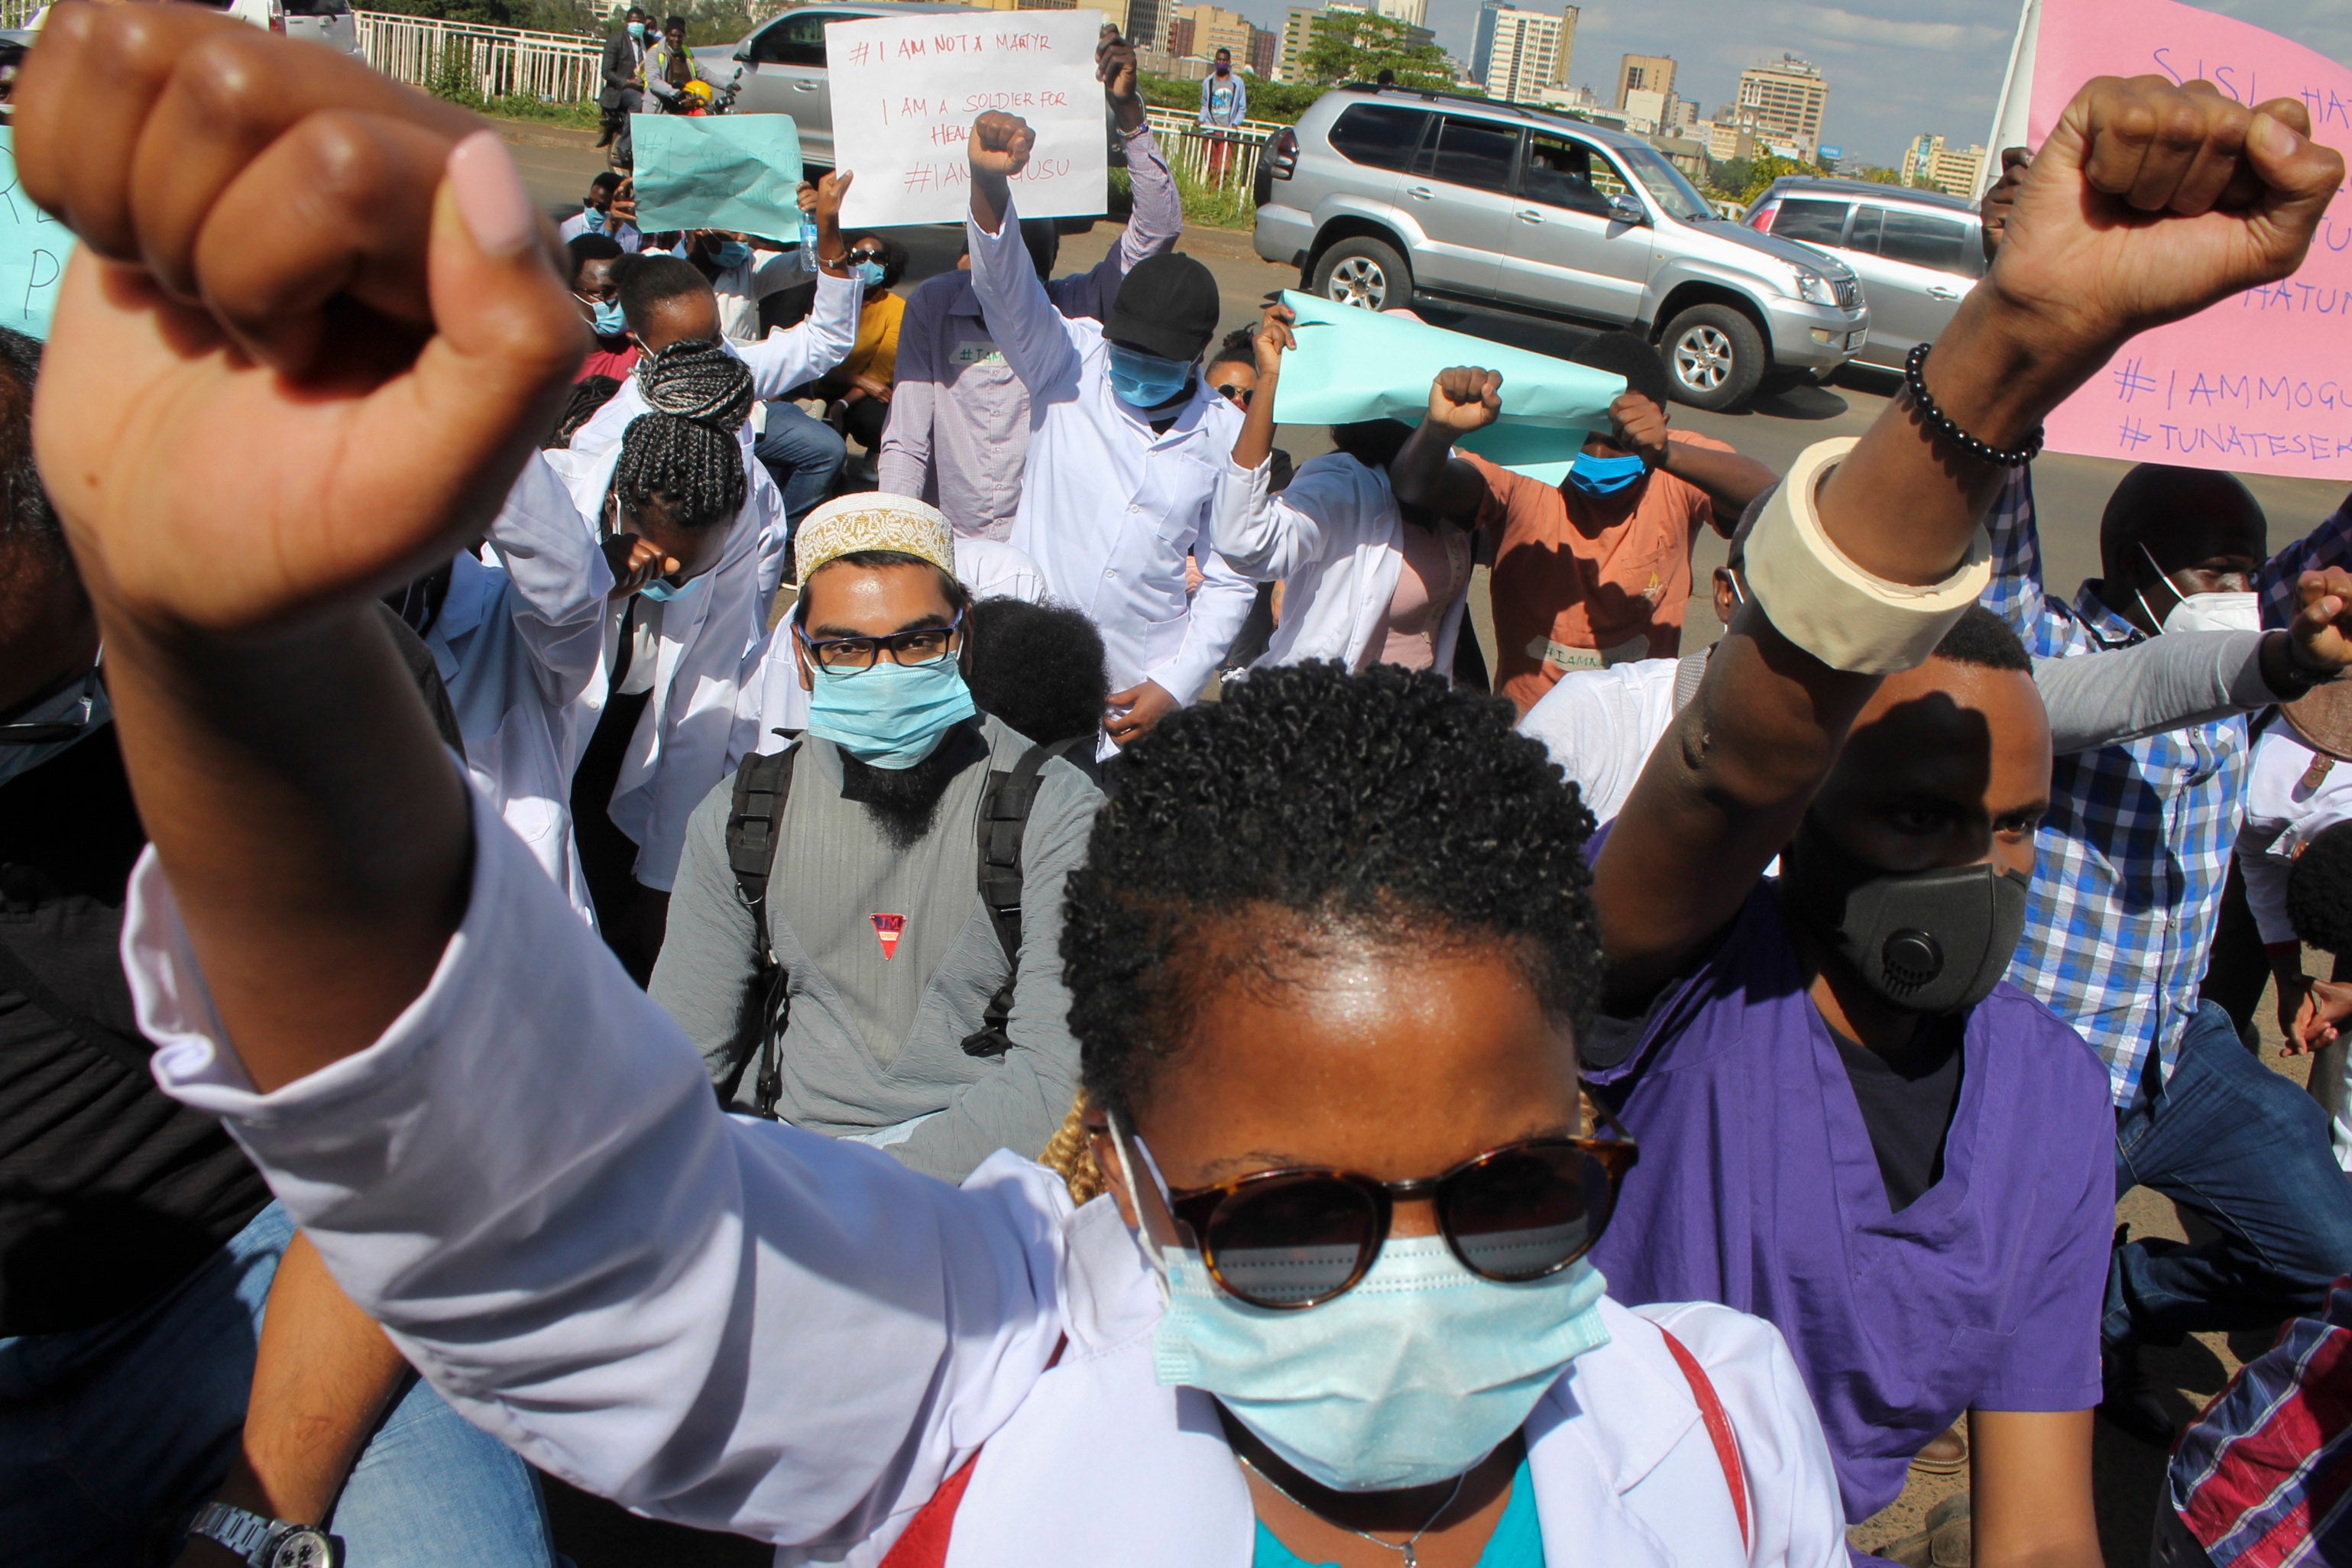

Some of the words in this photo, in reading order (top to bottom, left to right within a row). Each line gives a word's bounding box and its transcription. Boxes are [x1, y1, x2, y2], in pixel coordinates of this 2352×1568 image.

[898, 38, 926, 60] AM
[935, 34, 967, 54] NOT
[996, 32, 1052, 53] MARTYR
[882, 99, 888, 125] I
[901, 97, 927, 118] AM
[939, 99, 949, 115] A
[962, 92, 1035, 112] SOLDIER
[1040, 91, 1067, 108] FOR
[2301, 86, 2352, 129] HA
[931, 123, 972, 147] HEAL
[904, 158, 1070, 193] #IAMUSU
